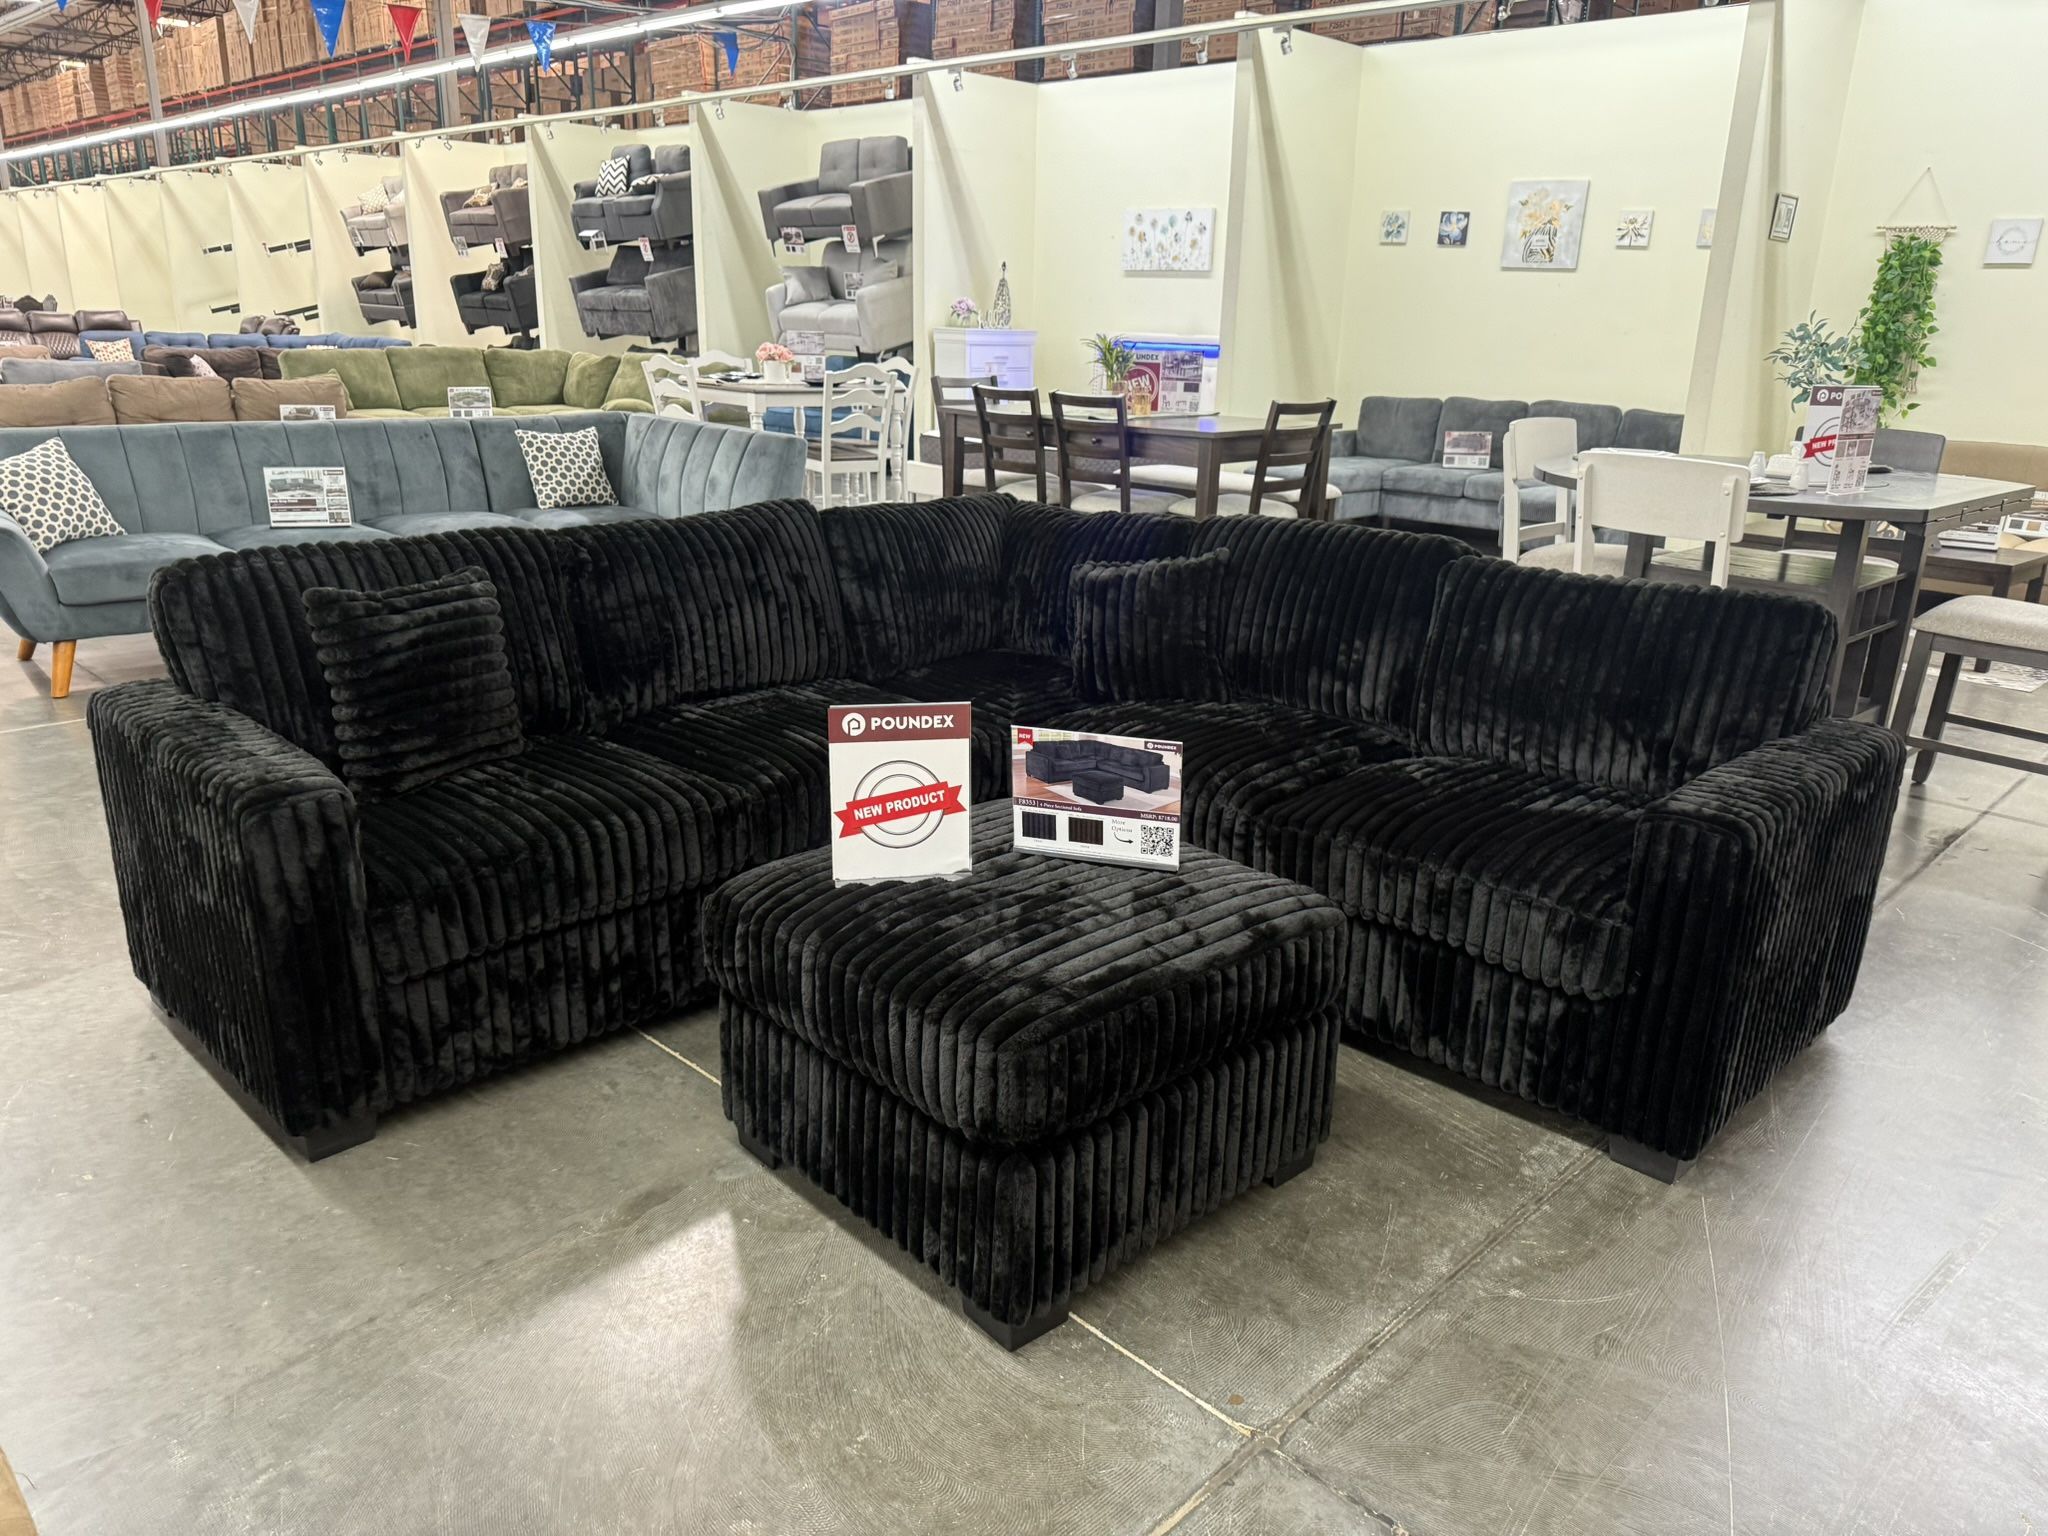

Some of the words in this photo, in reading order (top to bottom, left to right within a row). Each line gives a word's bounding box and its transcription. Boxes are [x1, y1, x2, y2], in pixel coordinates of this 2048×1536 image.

[1135, 353, 1160, 361] UNDEX
[1812, 440, 1827, 450] NEW
[871, 714, 954, 730] POUNDEX
[854, 804, 882, 820] NEW
[886, 790, 945, 813] PRODUCT
[1111, 825, 1133, 833] Options
